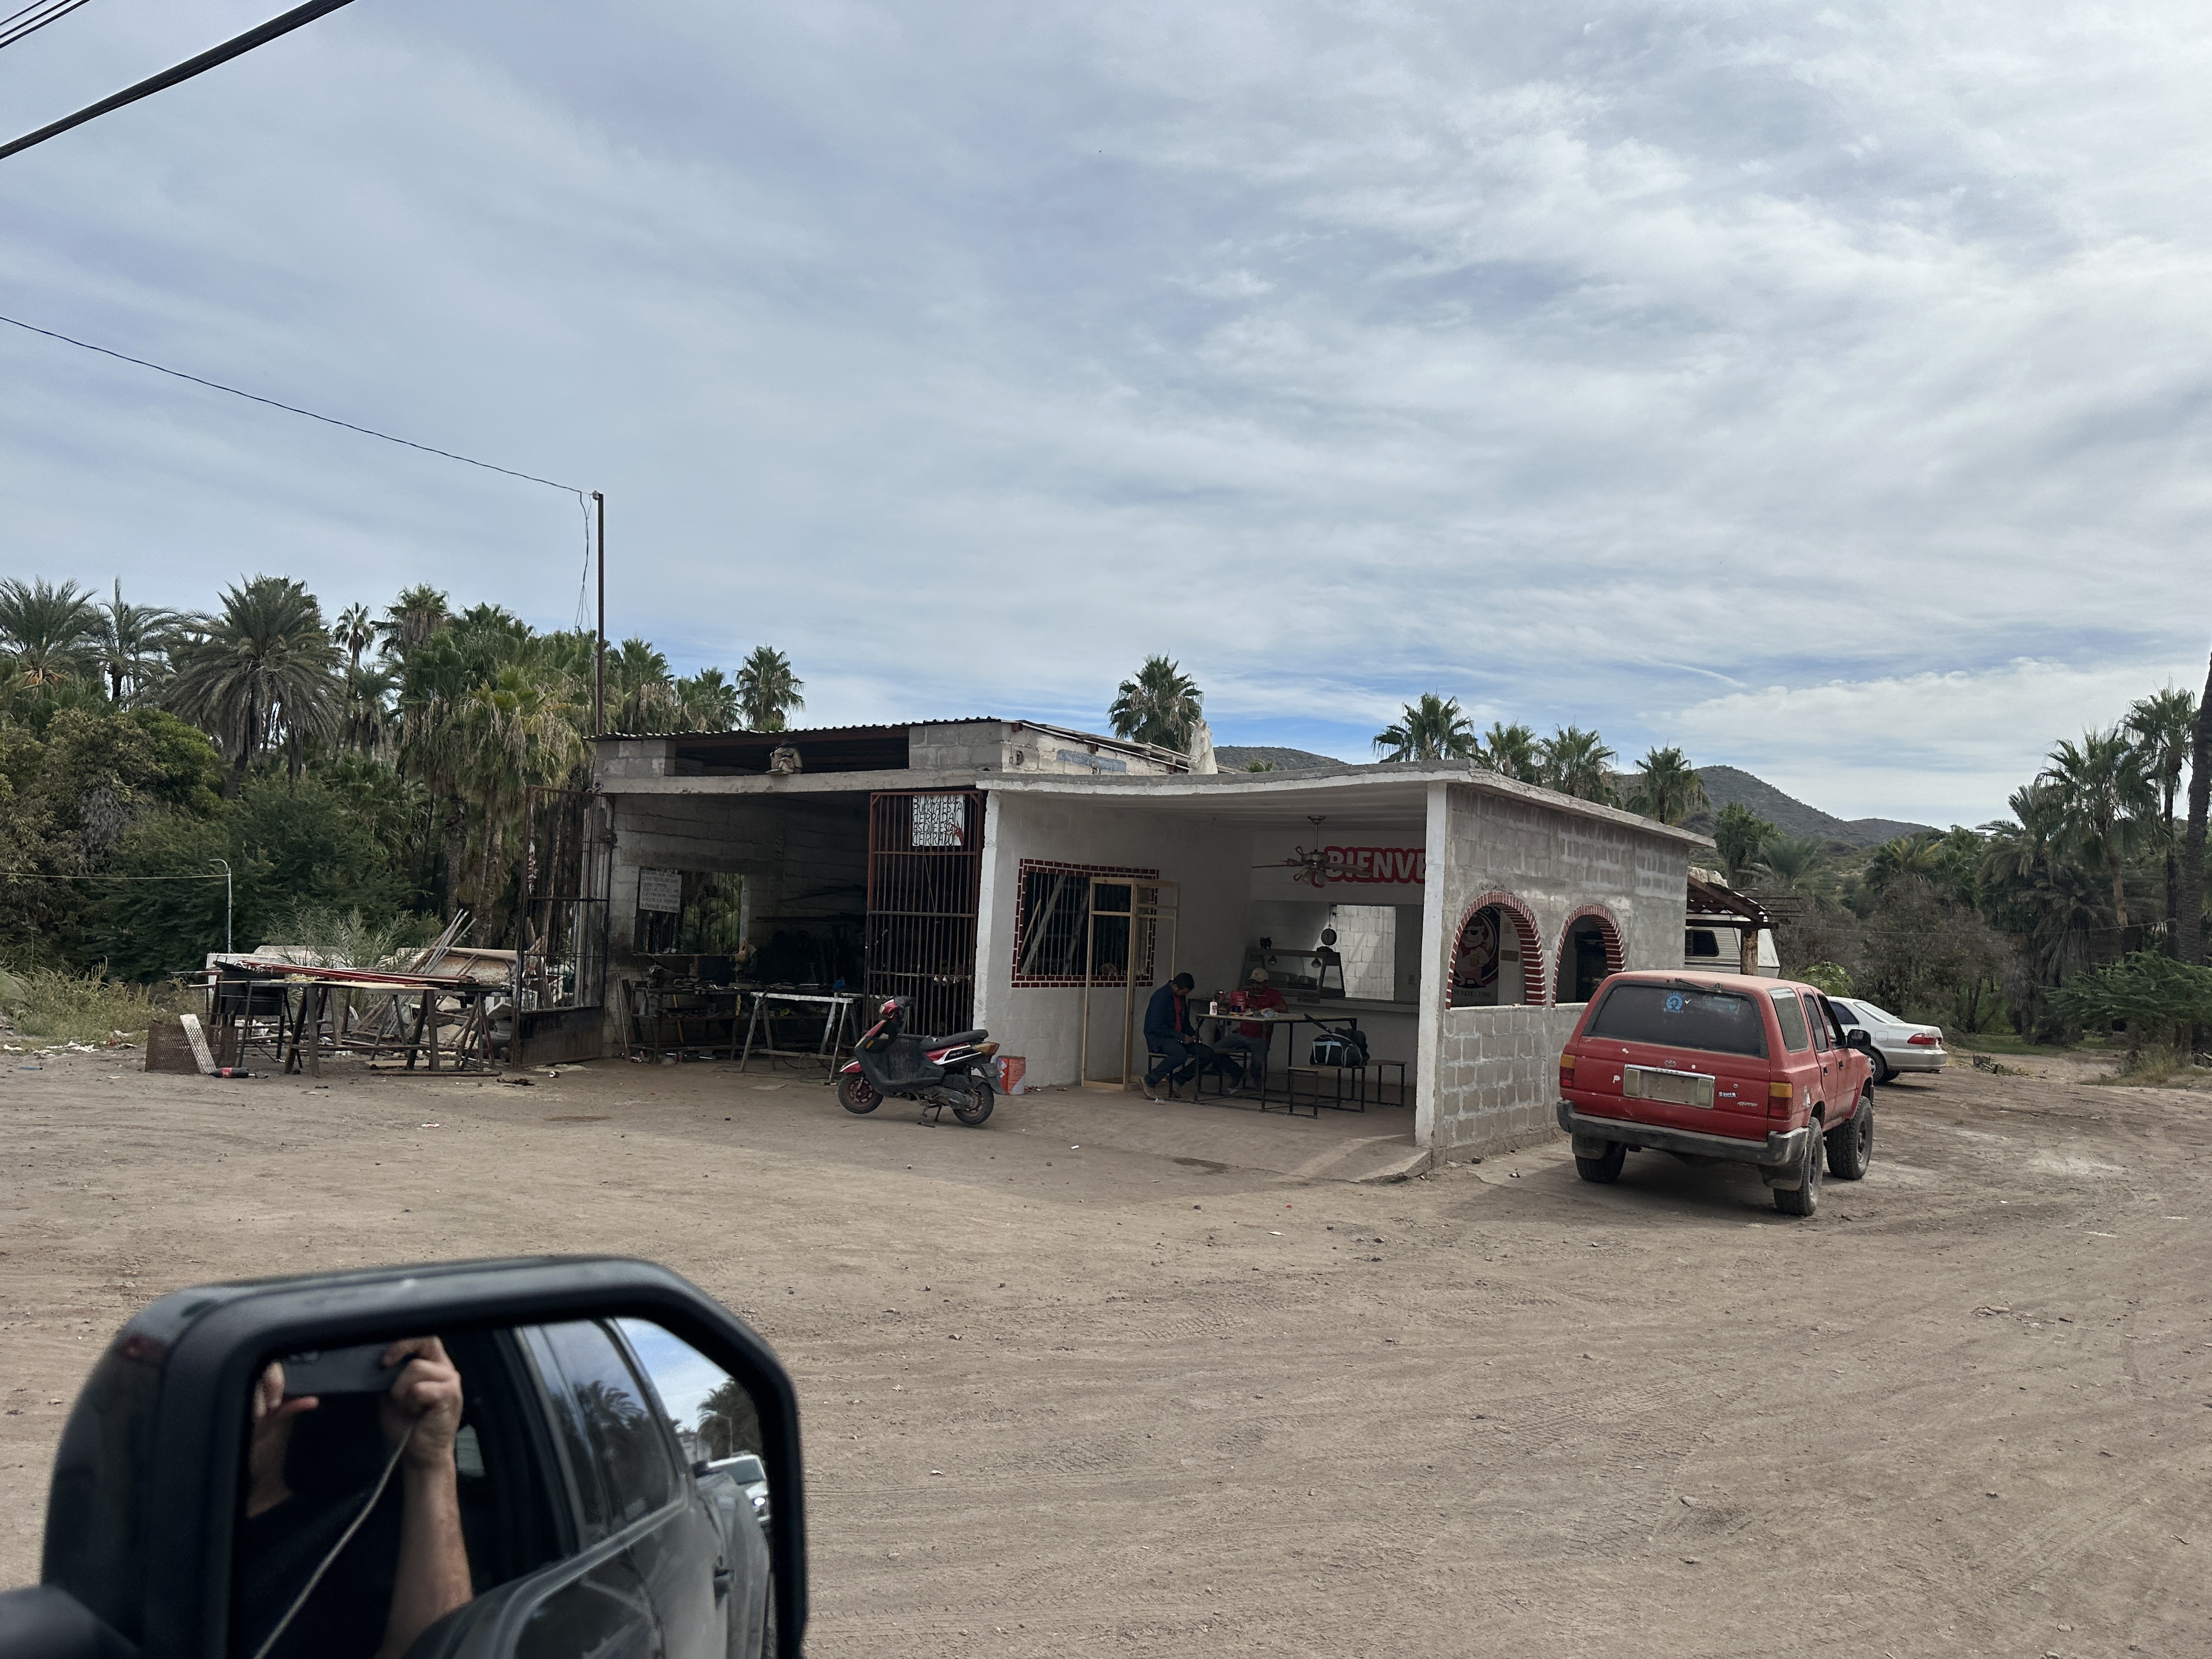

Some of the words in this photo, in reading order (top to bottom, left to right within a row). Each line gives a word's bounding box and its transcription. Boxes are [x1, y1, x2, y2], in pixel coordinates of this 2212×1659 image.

[913, 802, 940, 813] PUERTA
[943, 802, 962, 813] ESTA
[913, 812, 954, 823] CERRADA
[940, 822, 953, 833] ESTA
[913, 832, 953, 845] CERRADO
